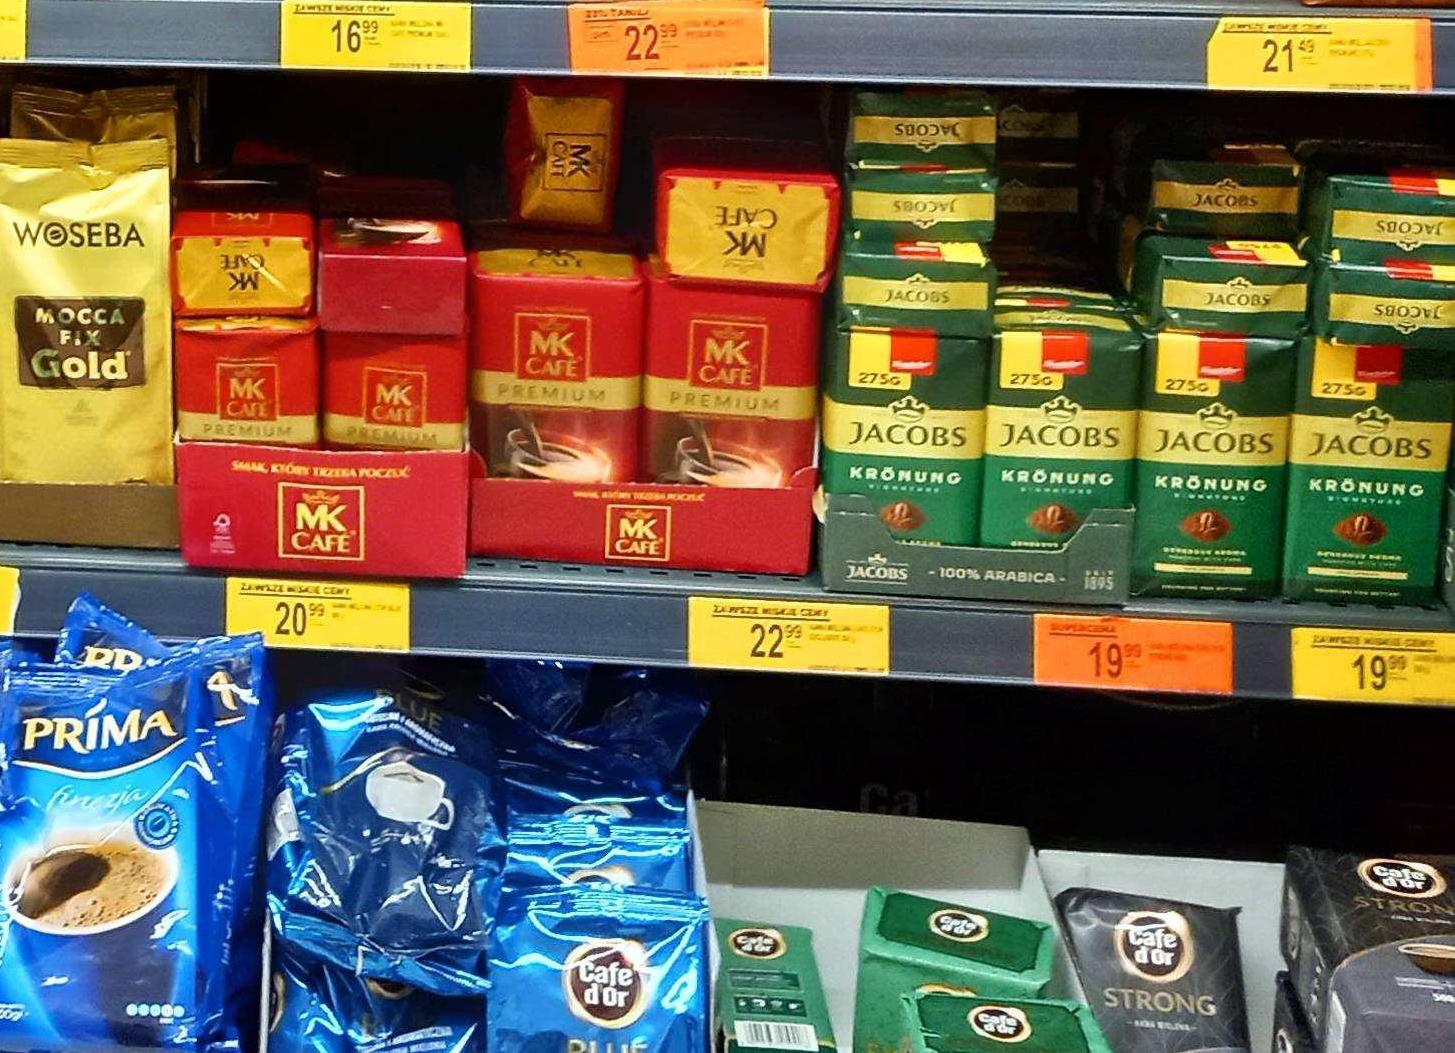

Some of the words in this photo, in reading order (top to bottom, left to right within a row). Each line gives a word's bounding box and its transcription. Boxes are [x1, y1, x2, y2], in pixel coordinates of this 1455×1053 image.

[332, 20, 361, 53] 16
[363, 21, 378, 33] 99
[1192, 193, 1259, 209] JACOBS
[13, 222, 144, 247] WOSEBA
[885, 289, 950, 304] JACOBS
[1206, 292, 1271, 307] JACOBS
[35, 308, 125, 324] MOCCA
[60, 329, 100, 346] FIX
[529, 332, 574, 357] MK
[704, 342, 749, 366] MK
[31, 350, 129, 380] Gold
[229, 378, 267, 400] MK
[376, 382, 414, 406] MK
[498, 384, 606, 402] PREMIUM
[670, 391, 780, 411] PREMIUM
[203, 424, 292, 437] PREMIUM
[849, 420, 967, 448] JACOBS
[1001, 423, 1120, 449] JACOBS
[1155, 430, 1274, 455] JACOBS
[1309, 432, 1432, 460] JACOBS
[850, 465, 962, 485] KRÖNUNG
[1001, 468, 1114, 487] KRÖNUNG
[1154, 475, 1267, 492] KRÖNUNG
[1309, 479, 1424, 497] KRÖNUNG
[296, 503, 347, 533] MK
[620, 520, 658, 541] MK
[847, 563, 908, 580] JACOBS
[985, 570, 1055, 583] ARABICA
[1084, 576, 1114, 590] 1895
[275, 602, 306, 635] 20
[750, 624, 783, 658] 22
[1128, 928, 1177, 948] Cafe
[579, 962, 633, 988] Cafe
[583, 981, 630, 1008] d'Or
[1105, 989, 1216, 1016] STRONG
